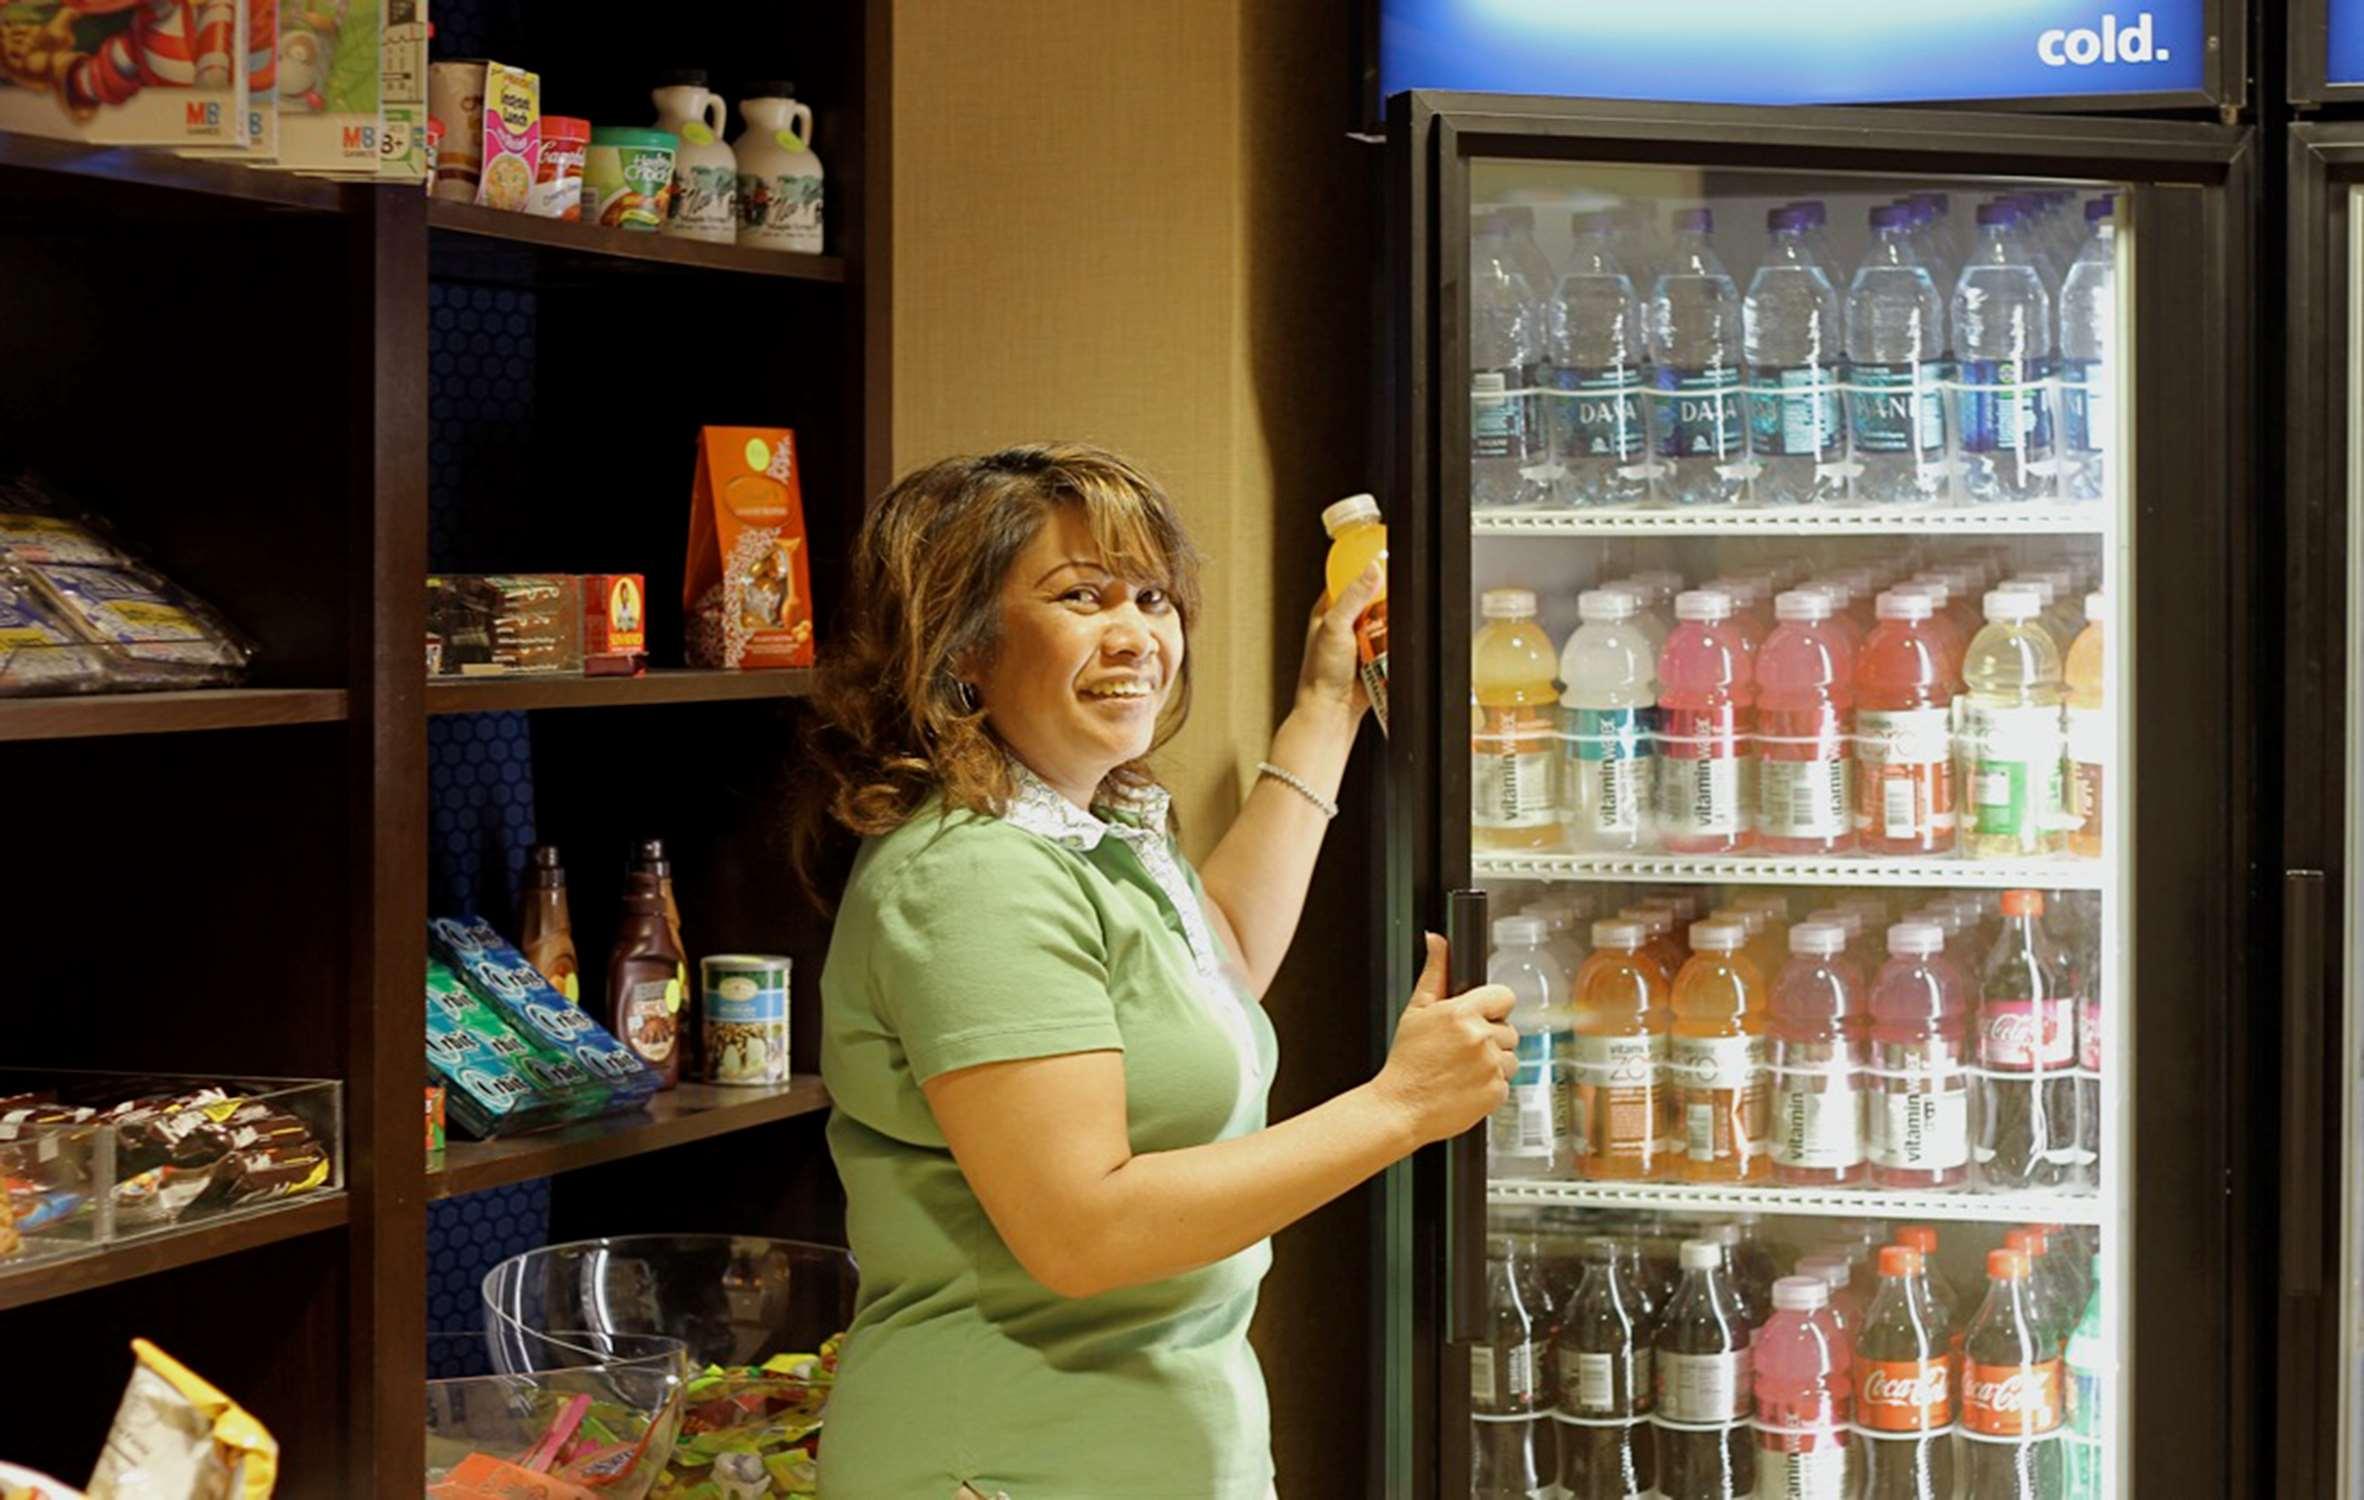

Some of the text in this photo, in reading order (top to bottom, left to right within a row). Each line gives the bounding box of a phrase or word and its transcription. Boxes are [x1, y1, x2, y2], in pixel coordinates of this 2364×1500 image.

[2037, 12, 2169, 66] cold.
[186, 101, 221, 125] MB
[343, 126, 376, 149] MB
[380, 133, 403, 154] 8+
